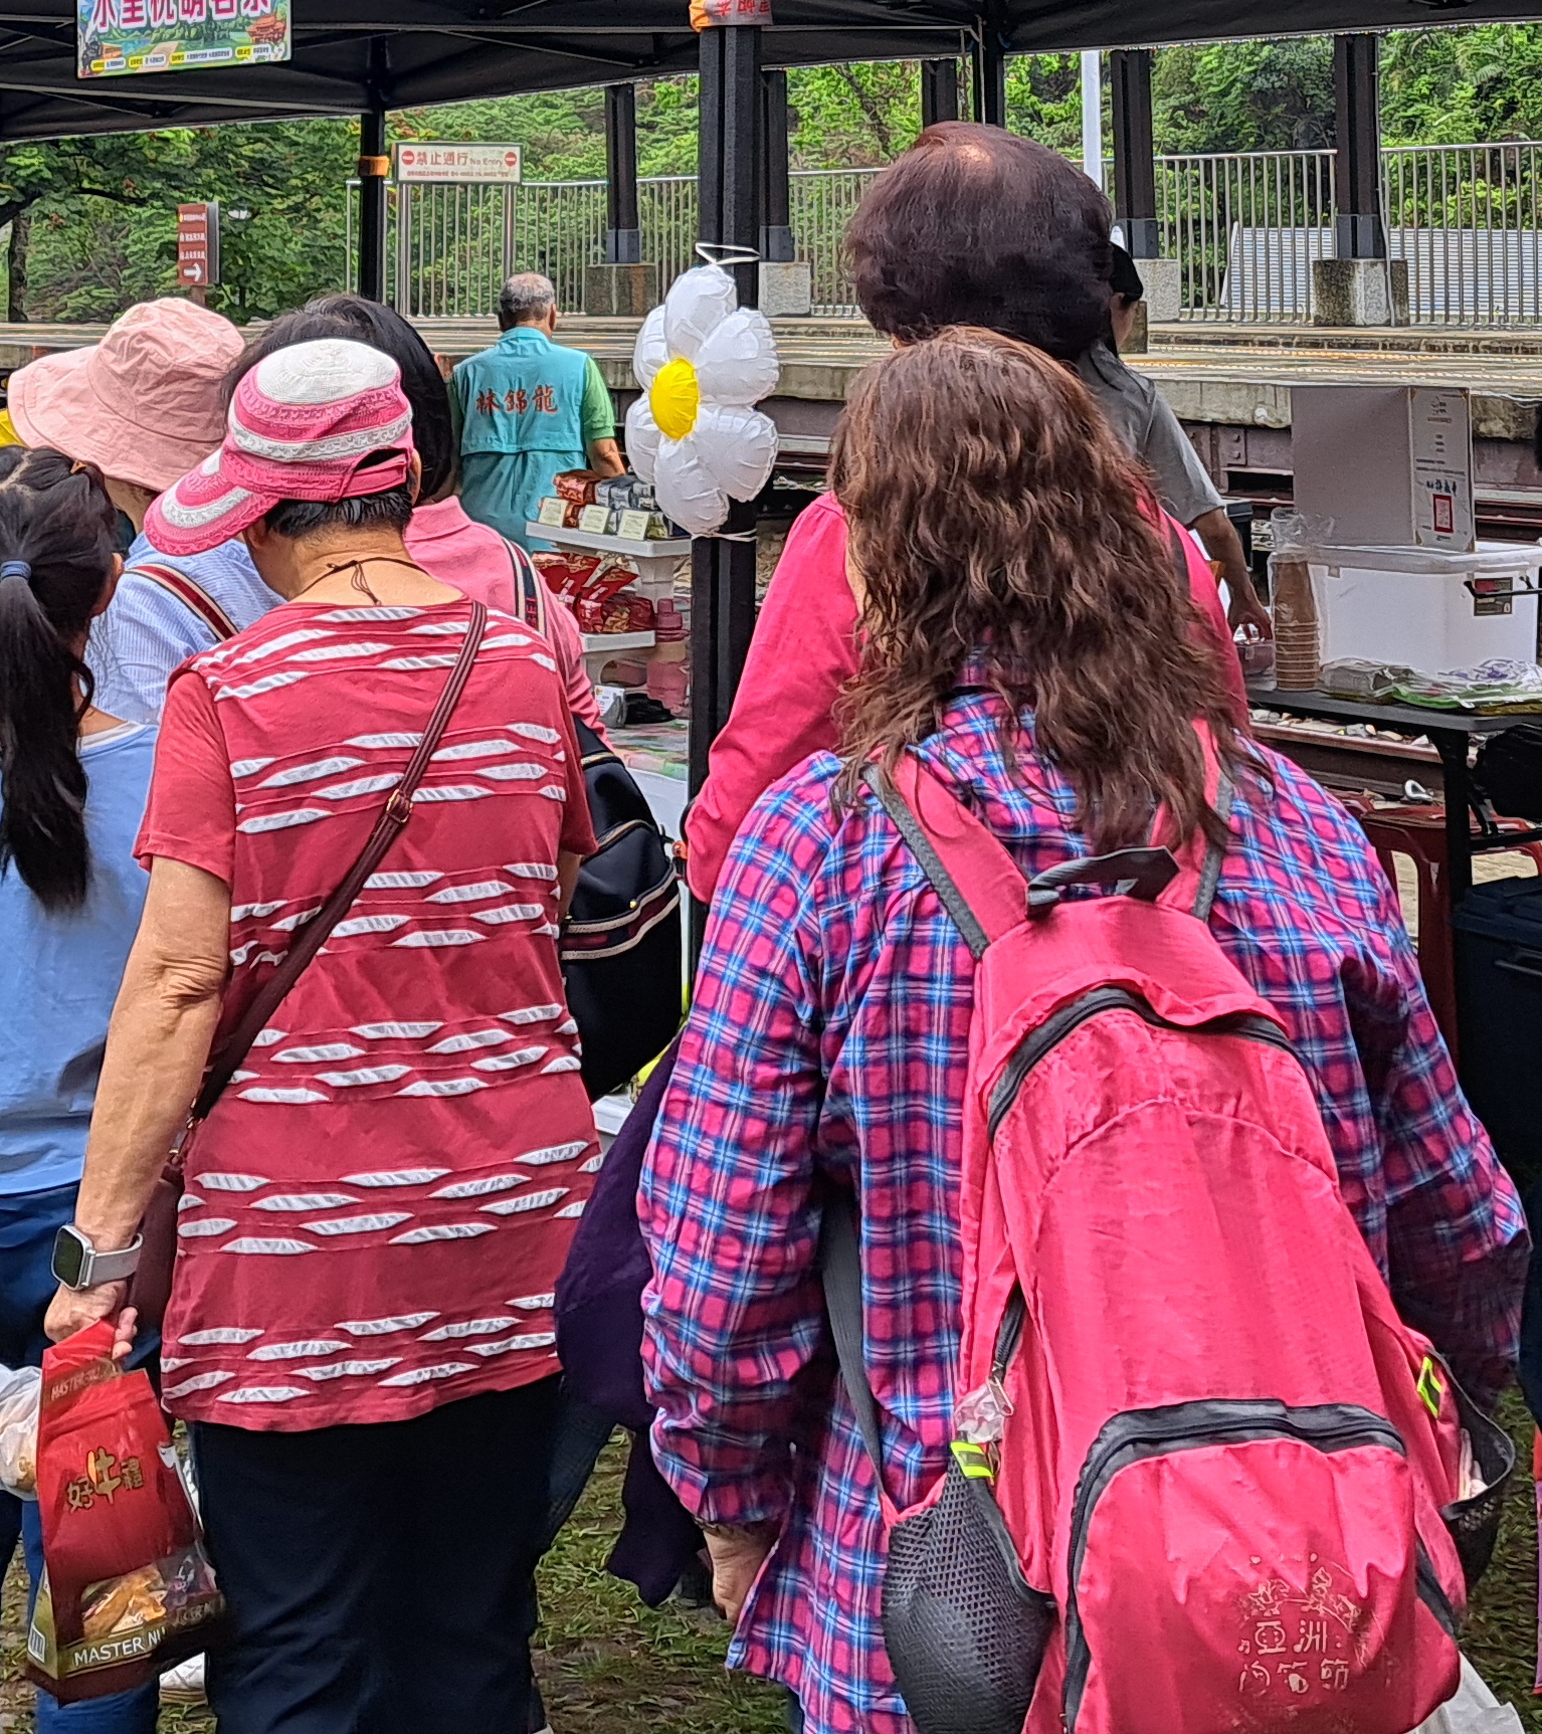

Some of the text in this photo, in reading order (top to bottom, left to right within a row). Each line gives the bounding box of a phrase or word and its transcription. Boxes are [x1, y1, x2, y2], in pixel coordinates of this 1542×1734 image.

[416, 150, 469, 166] 禁止通行
[475, 383, 559, 417] 林錦龍
[73, 1636, 145, 1667] MASTER
